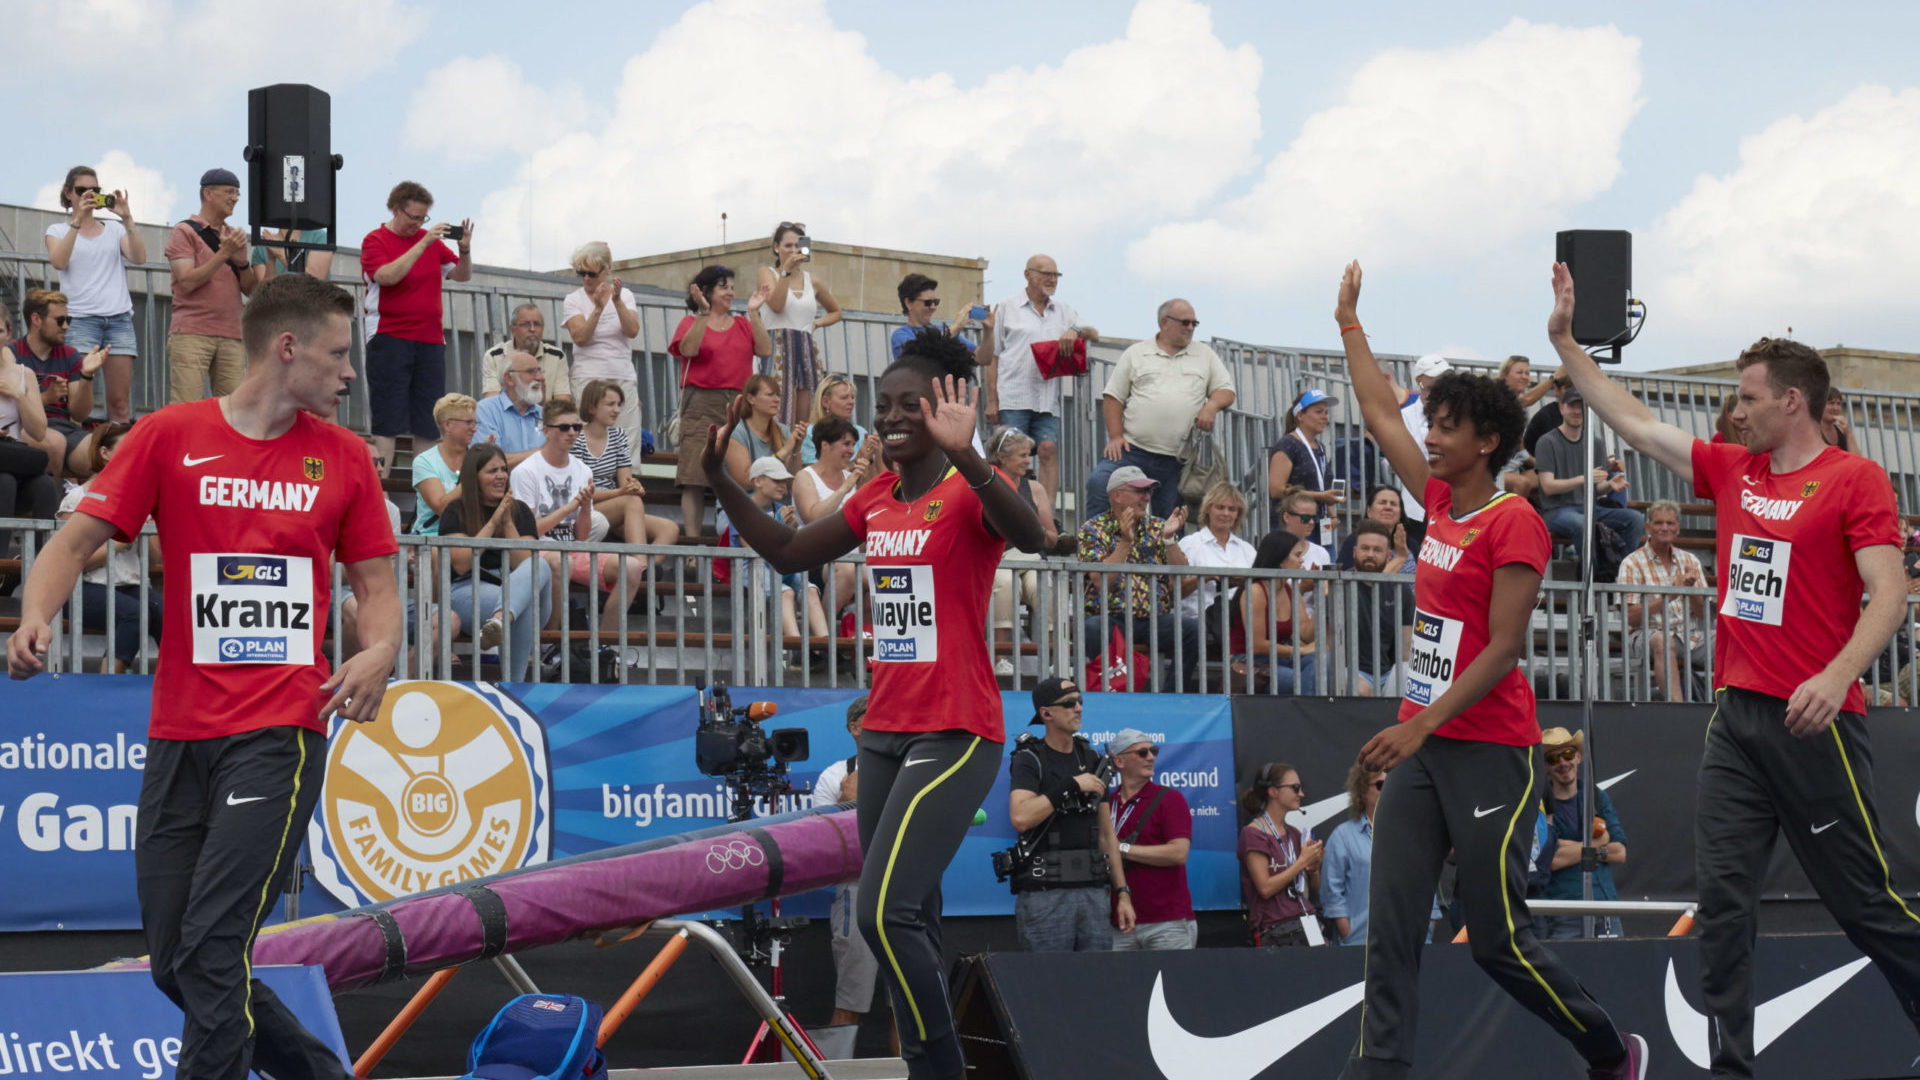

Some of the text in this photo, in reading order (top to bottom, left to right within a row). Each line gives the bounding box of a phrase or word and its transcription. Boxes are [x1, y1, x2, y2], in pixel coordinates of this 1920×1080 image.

[200, 476, 319, 512] GERMANY
[1741, 489, 1803, 520] GERMANY
[1756, 547, 1770, 559] GLS
[255, 565, 281, 580] GLS
[891, 576, 907, 588] GLS
[1730, 563, 1782, 598] Blech
[196, 593, 309, 630] Kranz
[1740, 601, 1763, 614] PLAN
[1423, 623, 1439, 638] GLS
[246, 640, 285, 652] PLAN
[888, 642, 914, 652] PLAN
[1412, 683, 1430, 698] PLAN
[1160, 766, 1219, 788] gesund
[412, 793, 448, 813] BIG
[1197, 805, 1220, 816] nicht.
[349, 816, 511, 892] FAMILY GAMES
